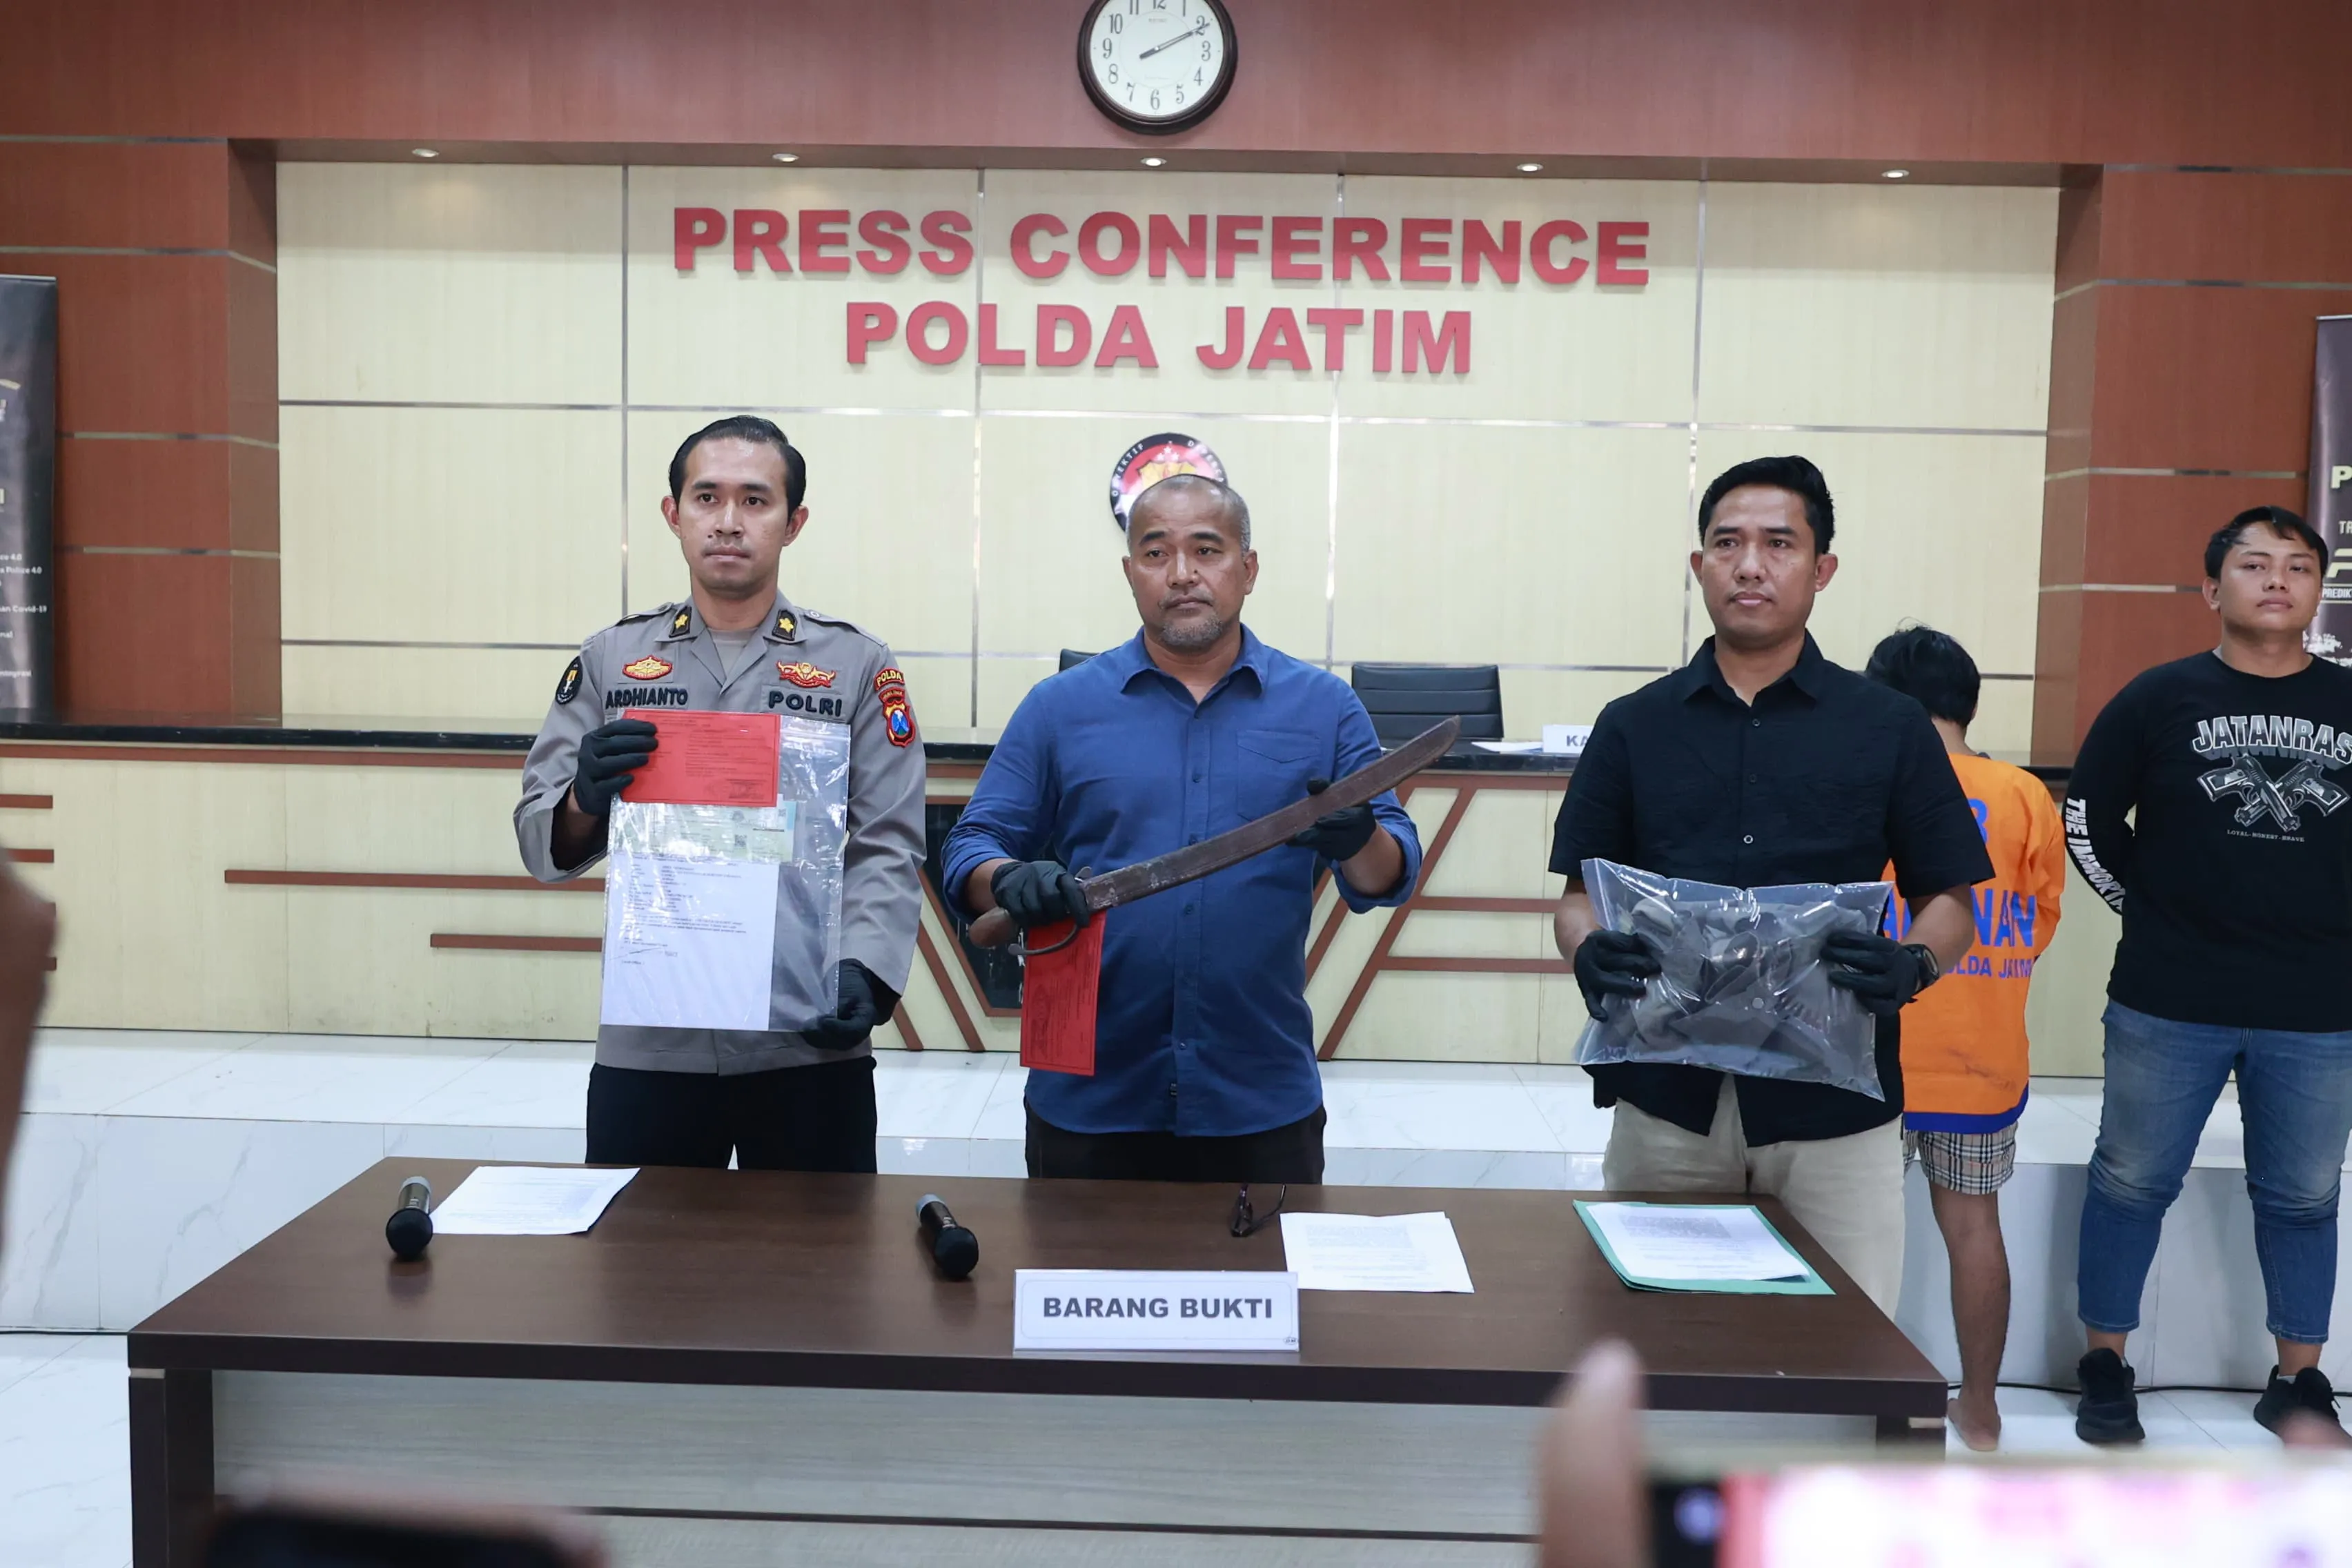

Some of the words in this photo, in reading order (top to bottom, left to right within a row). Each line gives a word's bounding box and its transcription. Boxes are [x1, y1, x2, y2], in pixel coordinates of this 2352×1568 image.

[1109, 13, 1123, 35] 10
[1195, 14, 1206, 36] 2
[1103, 37, 1113, 59] 9
[1201, 40, 1211, 61] 3
[1108, 63, 1119, 84] 8
[1193, 66, 1204, 86] 4
[1126, 81, 1136, 102] 7
[1150, 89, 1160, 110] 6
[1175, 84, 1184, 104] 5
[674, 207, 974, 275] PRESS
[1010, 210, 1649, 286] CONFERENCE
[846, 300, 1159, 369] POLDA
[1195, 306, 1471, 373] JATIM
[876, 669, 903, 687] POLDA
[605, 687, 688, 709] ARDHIANTO
[768, 690, 843, 717] POLRI
[2192, 714, 2352, 767] JATANRAS
[2065, 796, 2089, 836] THE
[1043, 1297, 1169, 1319] BARANG
[1180, 1297, 1272, 1319] BUKTI
